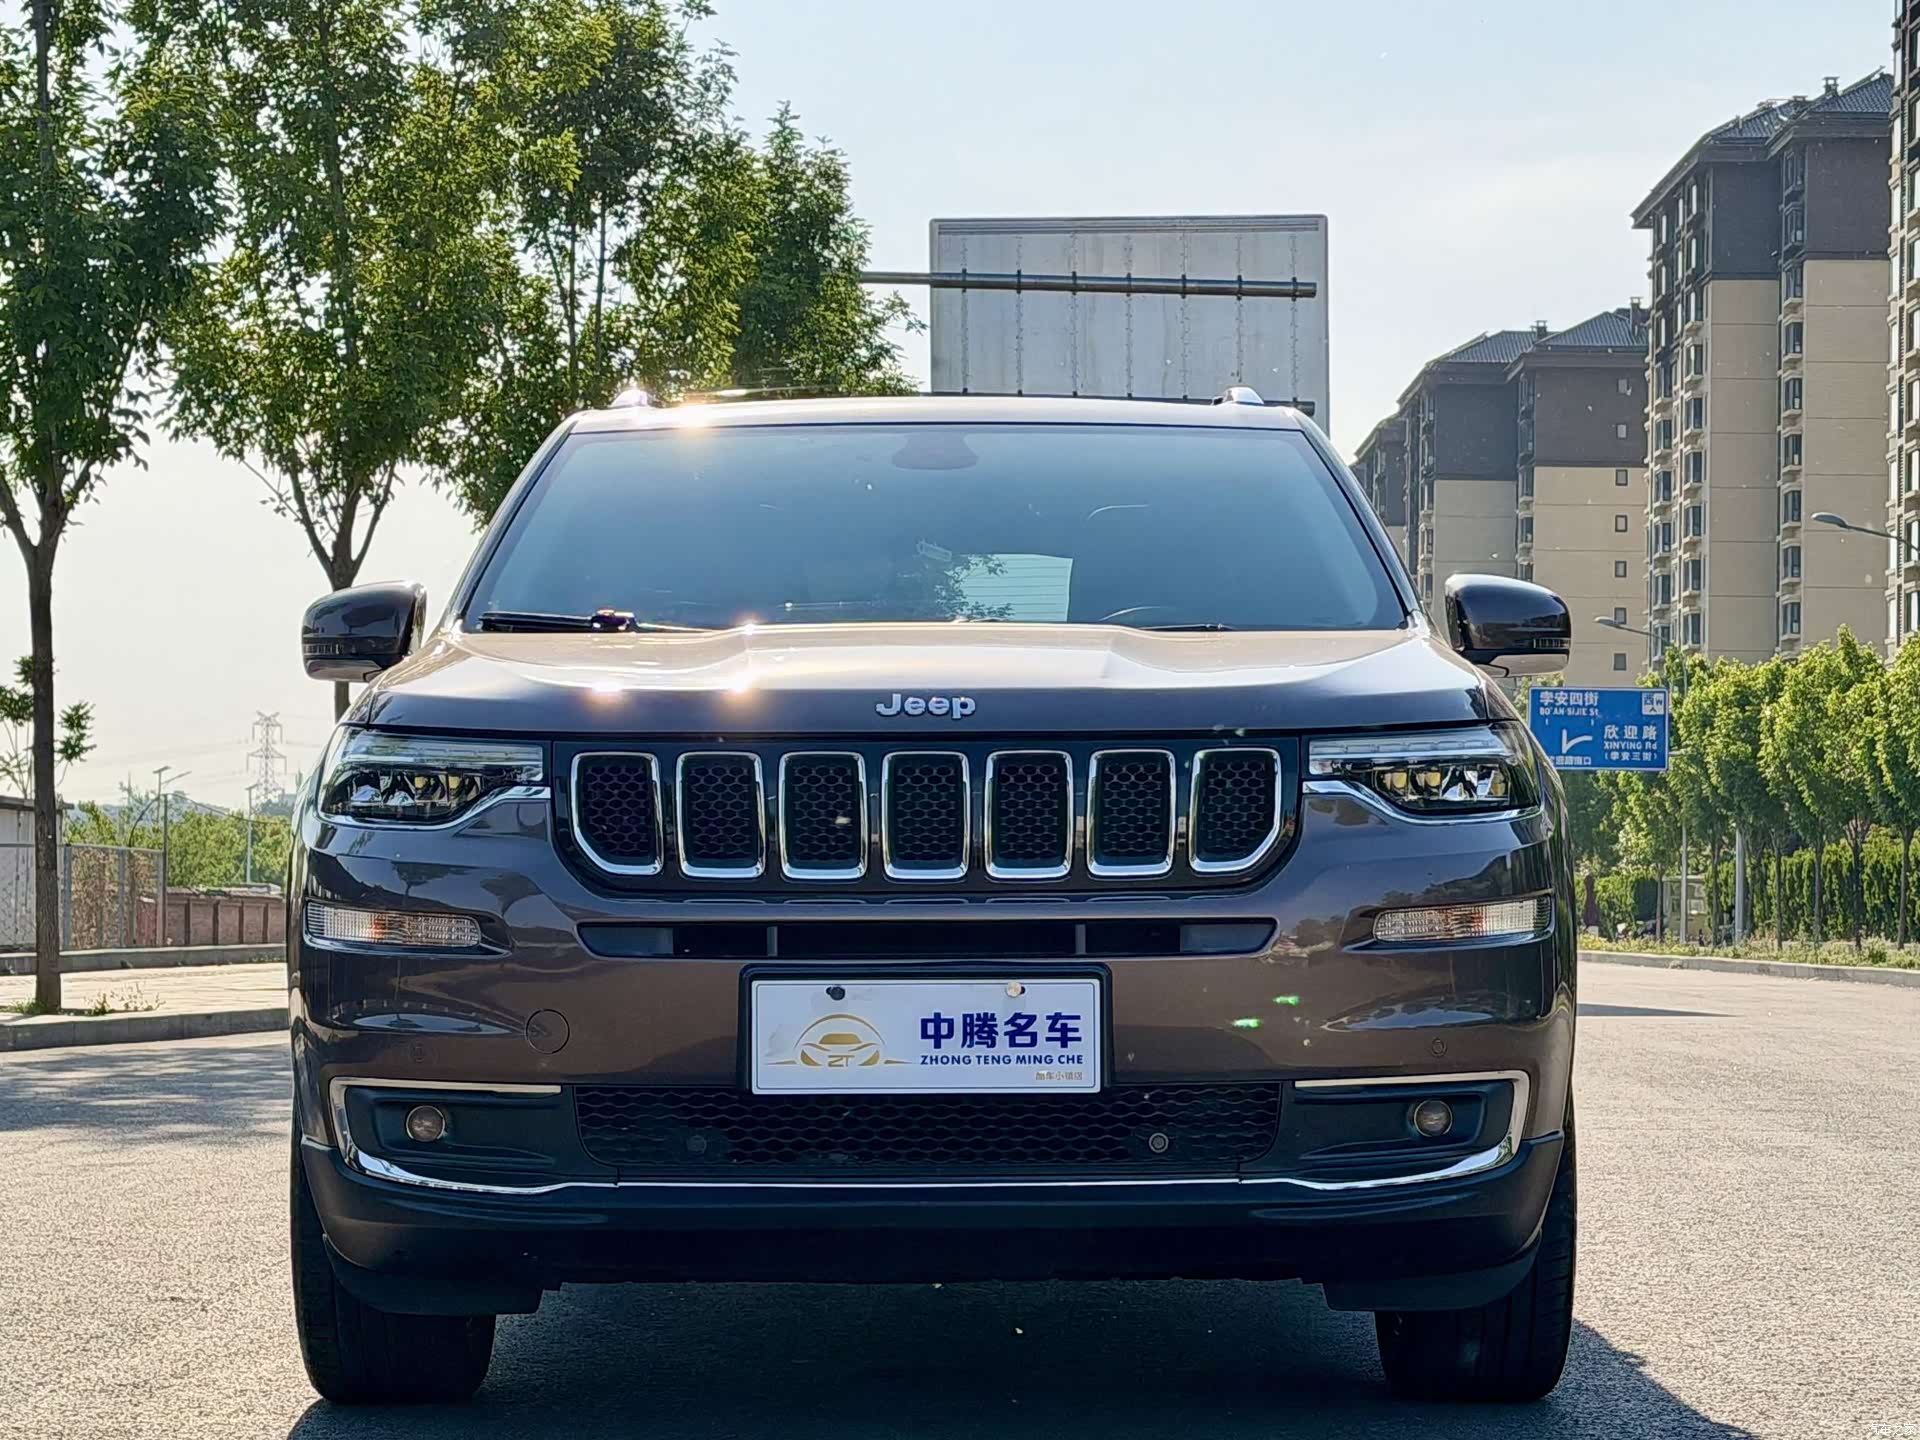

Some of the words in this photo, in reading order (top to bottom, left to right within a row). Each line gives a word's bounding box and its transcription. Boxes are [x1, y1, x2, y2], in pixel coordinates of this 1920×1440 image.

[875, 693, 976, 719] Jeep
[1604, 724, 1657, 740] 欣迎路
[1604, 741, 1642, 750] XINYING
[1645, 741, 1658, 750] Rd
[920, 1012, 1083, 1050] 中腾名车
[920, 1054, 973, 1066] ZHONG
[976, 1054, 1012, 1066] TENG
[1015, 1054, 1054, 1066] MING
[1057, 1053, 1084, 1066] CHE
